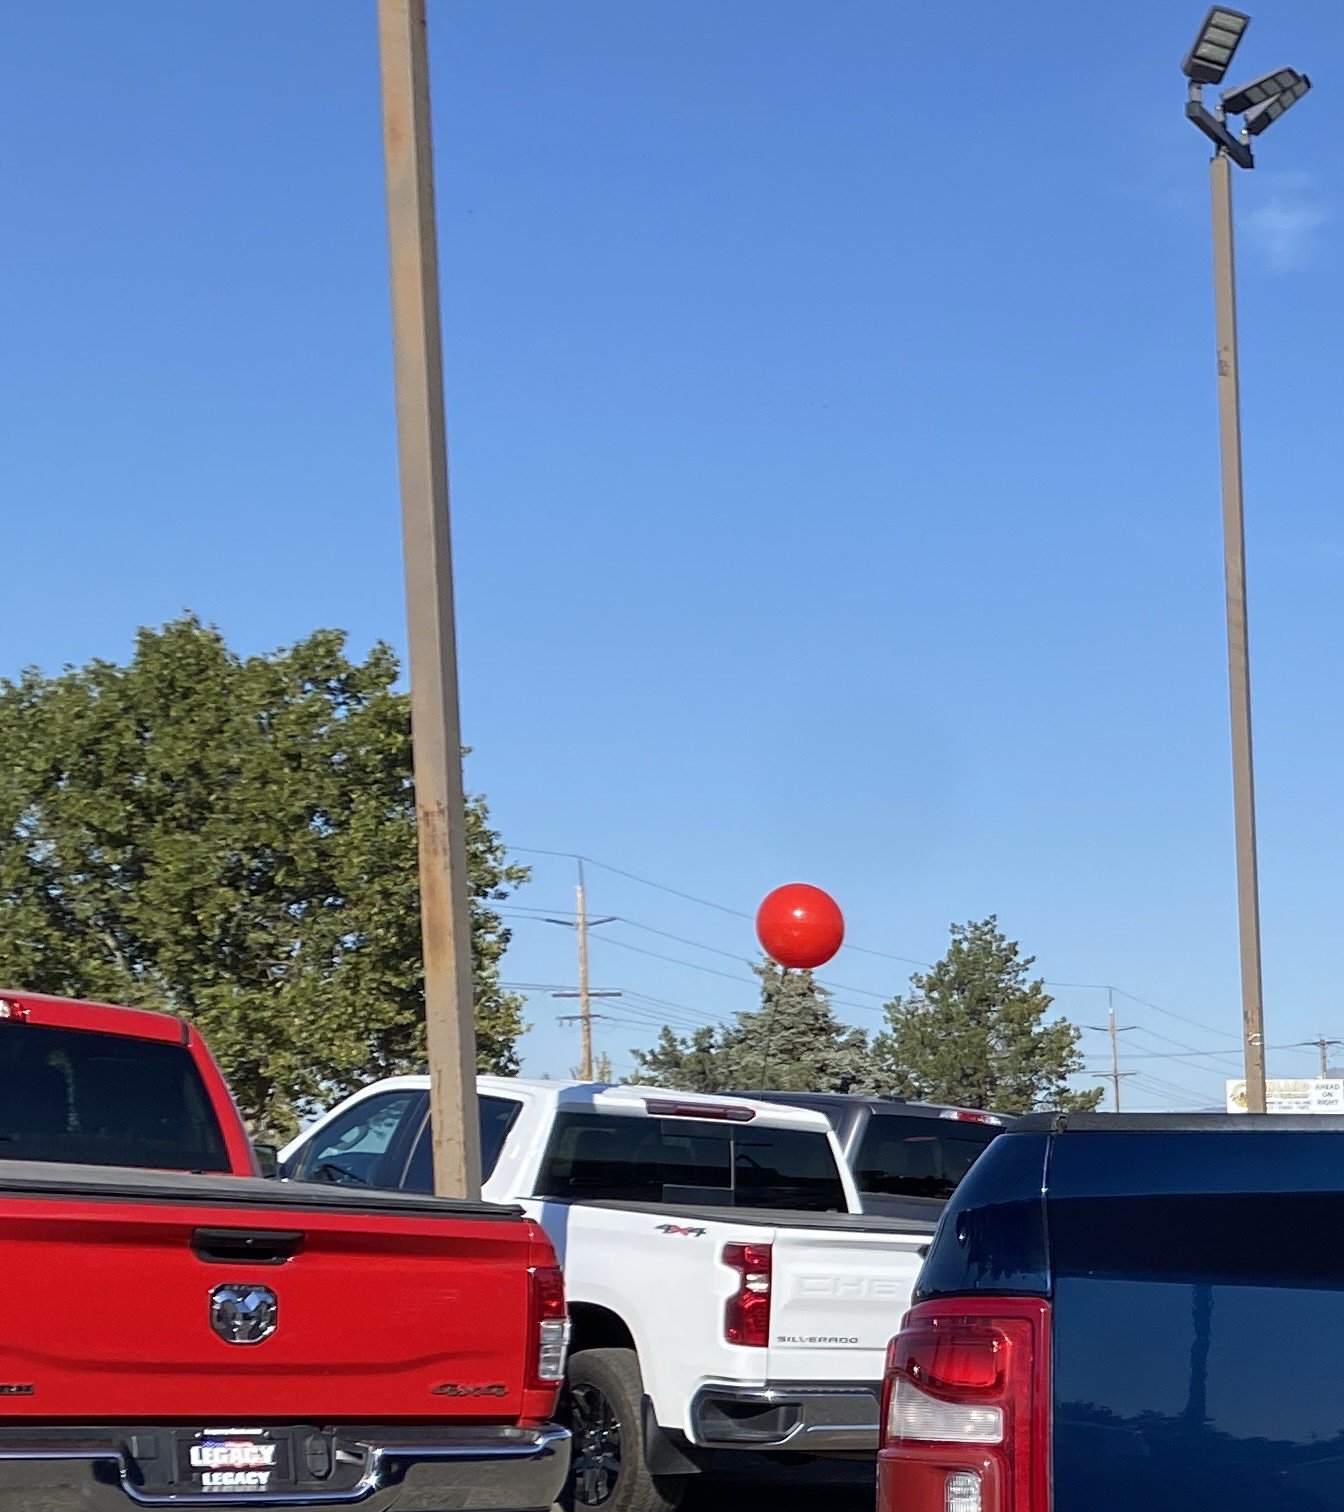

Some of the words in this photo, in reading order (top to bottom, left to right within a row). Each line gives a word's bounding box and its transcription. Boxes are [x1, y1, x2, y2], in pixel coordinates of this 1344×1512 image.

[776, 1336, 858, 1344] SILVERADO
[190, 1445, 276, 1467] LEGACY
[202, 1472, 271, 1485] LEGACY
